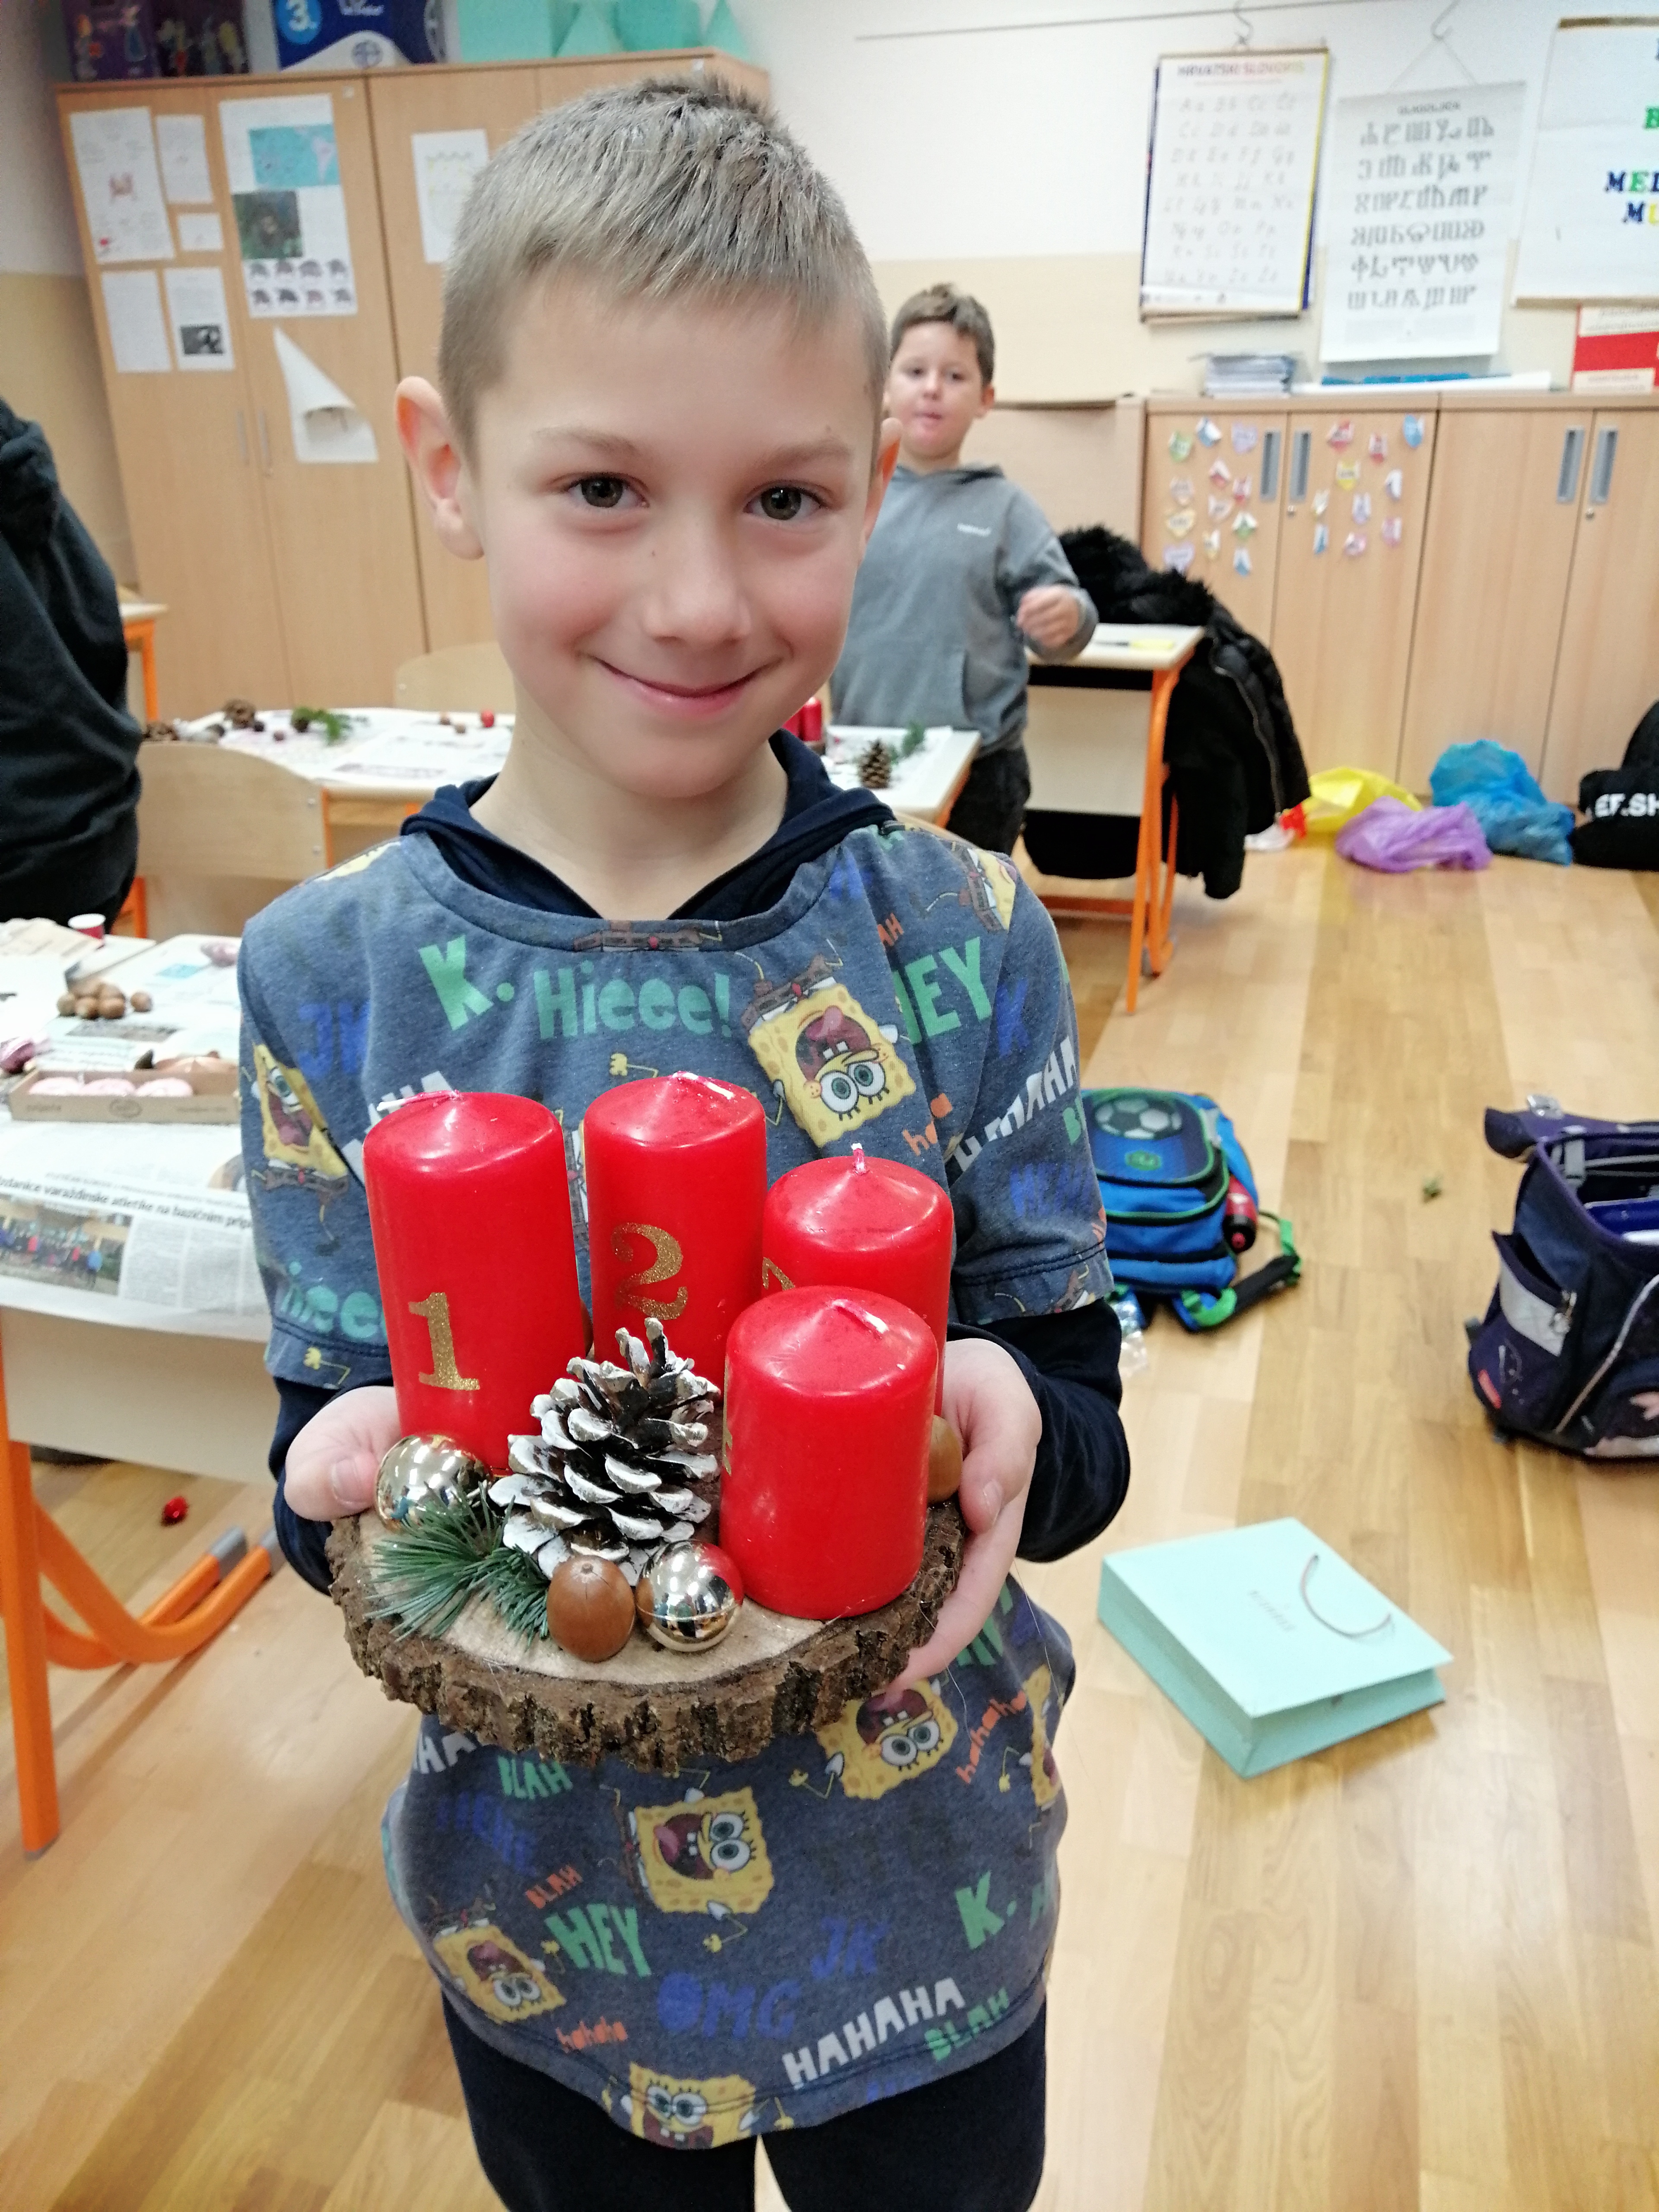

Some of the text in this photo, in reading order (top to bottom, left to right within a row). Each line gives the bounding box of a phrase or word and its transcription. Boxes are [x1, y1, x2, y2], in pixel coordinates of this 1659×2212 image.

[534, 960, 732, 1039] Hieee!
[611, 1222, 689, 1320] 2
[408, 1292, 480, 1391] 1
[544, 1902, 652, 1977] HEY
[782, 1977, 966, 2091] HAHAHA
